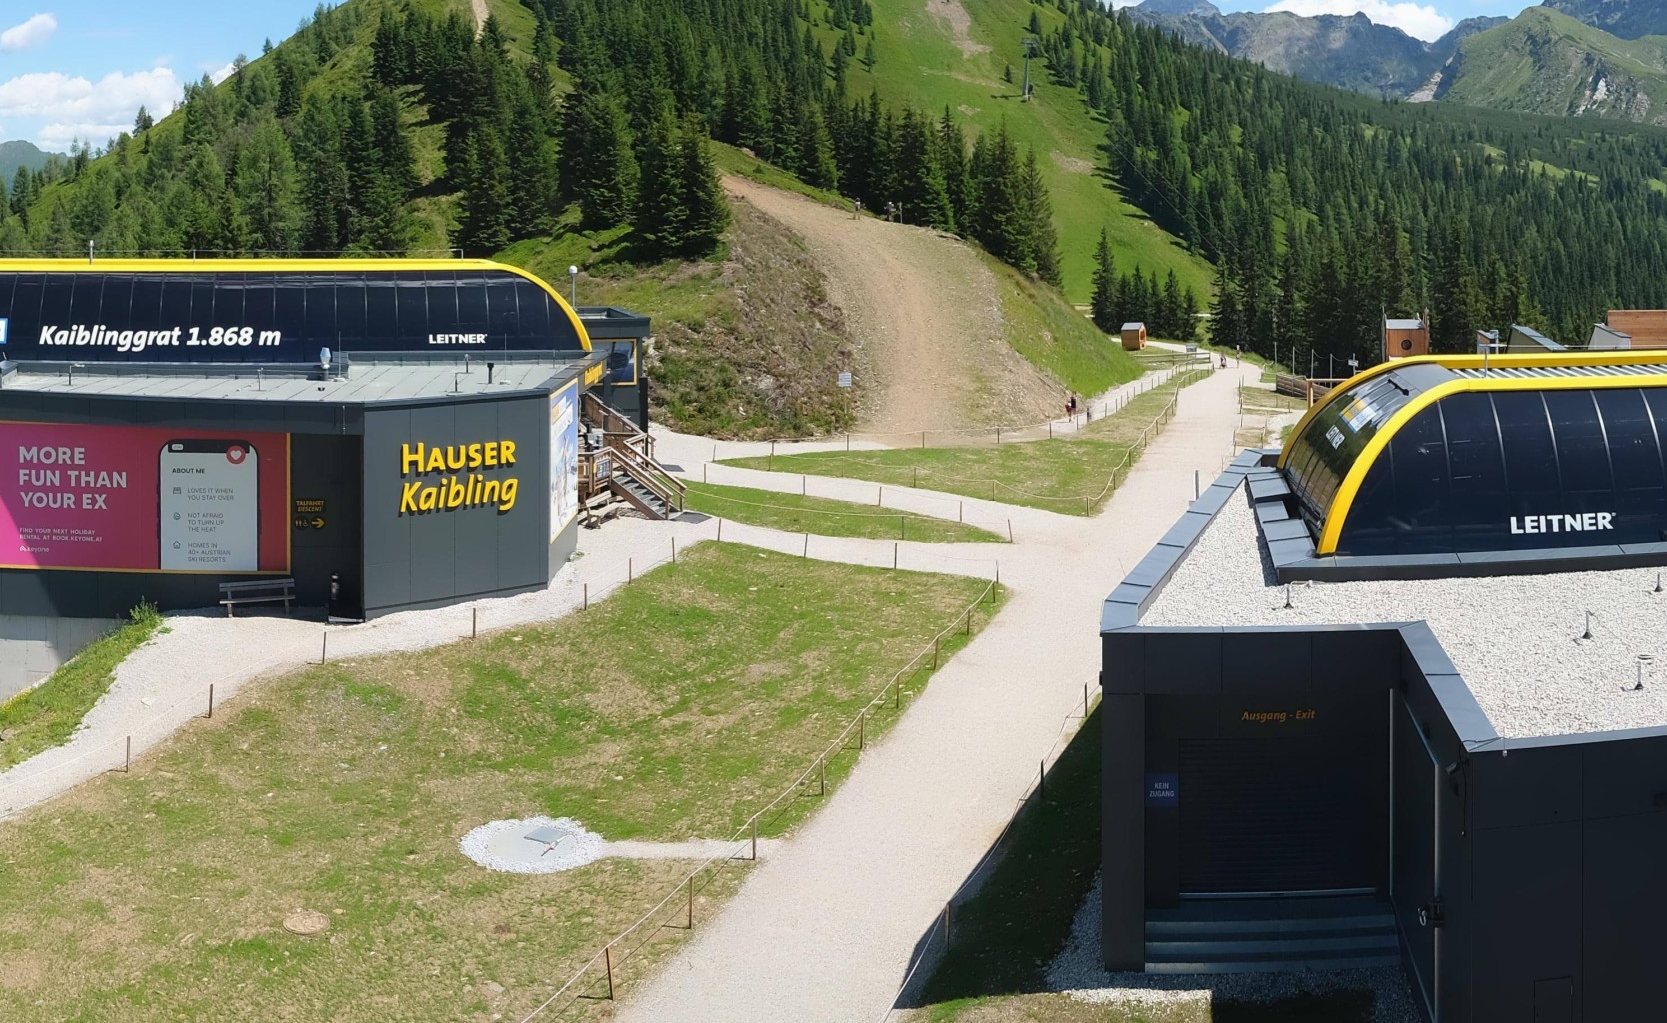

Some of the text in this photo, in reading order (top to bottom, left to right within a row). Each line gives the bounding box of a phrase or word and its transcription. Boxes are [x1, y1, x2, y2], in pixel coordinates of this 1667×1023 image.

[39, 324, 281, 352] Kaiblinggrat 1.868 m
[428, 333, 488, 344] LEITNER
[19, 446, 86, 465] MORE
[402, 440, 516, 474] HAUSER
[19, 469, 127, 488] FUN THAN
[20, 491, 108, 510] YOUR EX
[400, 474, 518, 512] Kaibling
[1510, 511, 1616, 534] LEITNER
[1241, 710, 1287, 723] Ausgang
[1295, 708, 1316, 720] Exit
[1149, 790, 1175, 798] ZUGANG
